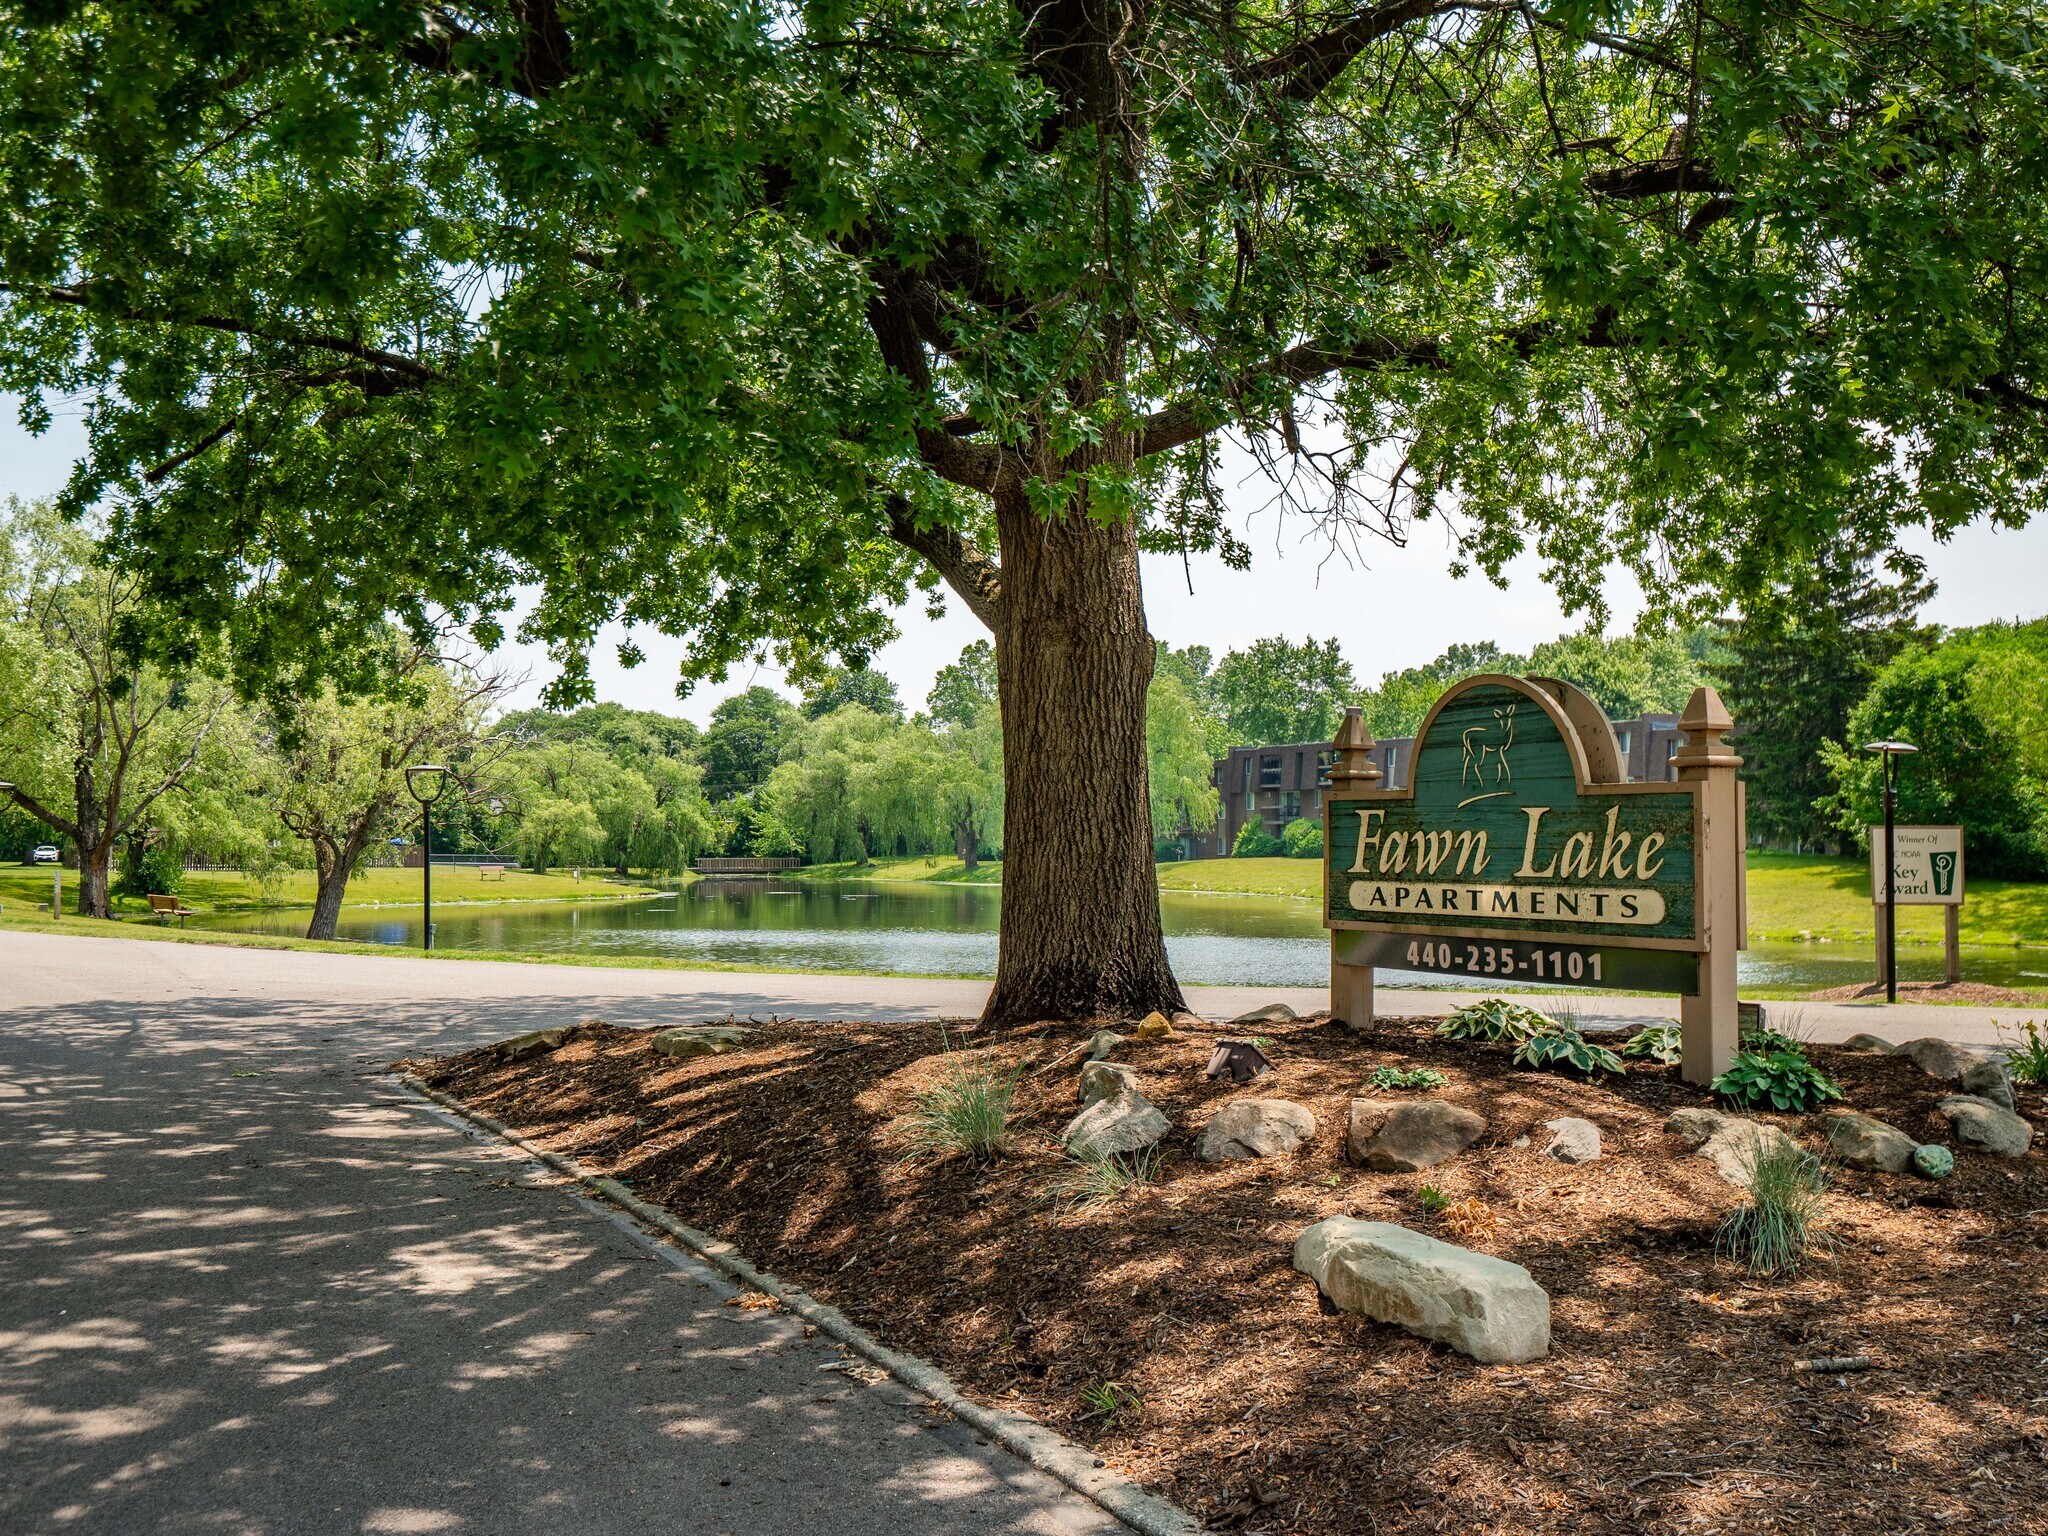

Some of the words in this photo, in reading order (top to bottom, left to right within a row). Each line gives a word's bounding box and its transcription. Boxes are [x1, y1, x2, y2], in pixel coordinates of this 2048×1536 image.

[1347, 809, 1491, 876] Fawn
[1514, 805, 1666, 881] Lake
[1897, 835, 1925, 843] Winner
[1927, 835, 1938, 844] Of
[1901, 850, 1921, 858] NOAA
[1369, 885, 1639, 919] APARTMENTS
[1406, 941, 1602, 981] 440-235-1101
